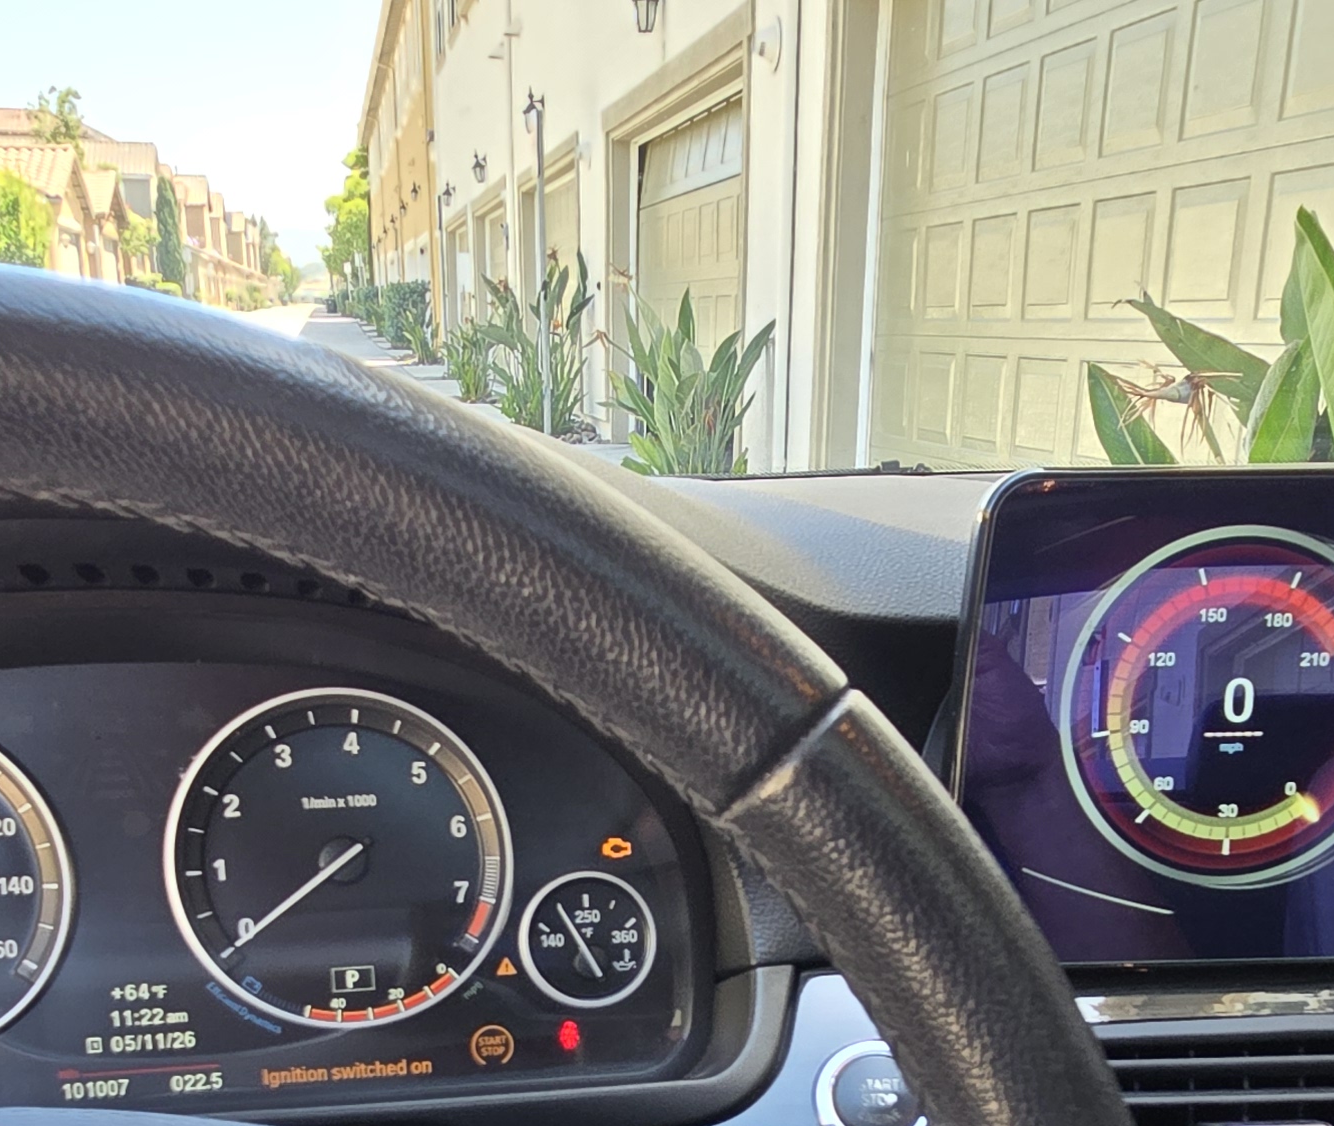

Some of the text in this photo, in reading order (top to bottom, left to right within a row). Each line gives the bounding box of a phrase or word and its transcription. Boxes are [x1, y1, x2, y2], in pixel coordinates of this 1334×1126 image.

[1199, 608, 1227, 622] 150
[1266, 613, 1293, 627] 180
[1148, 652, 1176, 666] 120
[1300, 652, 1330, 667] 210
[1224, 678, 1255, 723] 0
[1129, 720, 1149, 733] 90
[343, 732, 360, 755] 4
[274, 744, 292, 768] 3
[411, 761, 427, 784] 5
[1153, 776, 1174, 791] 60
[1284, 782, 1296, 795] 0
[222, 794, 241, 817] 2
[346, 794, 377, 807] 1000
[1218, 804, 1238, 818] 30
[450, 815, 467, 838] 6
[213, 859, 226, 881] 1
[453, 880, 469, 903] 7
[574, 910, 600, 923] 250
[238, 918, 255, 942] 0
[611, 930, 638, 943] 360
[540, 933, 565, 947] 140
[436, 963, 447, 974] 0
[345, 970, 359, 988] P
[388, 988, 405, 999] 20
[330, 998, 346, 1010] 40
[110, 1031, 197, 1052] 05/11/26
[478, 1034, 507, 1047] START
[481, 1045, 506, 1057] STOP
[262, 1059, 432, 1088] Ignition switched on
[170, 1071, 223, 1092] 022.5
[62, 1079, 130, 1100] 101007
